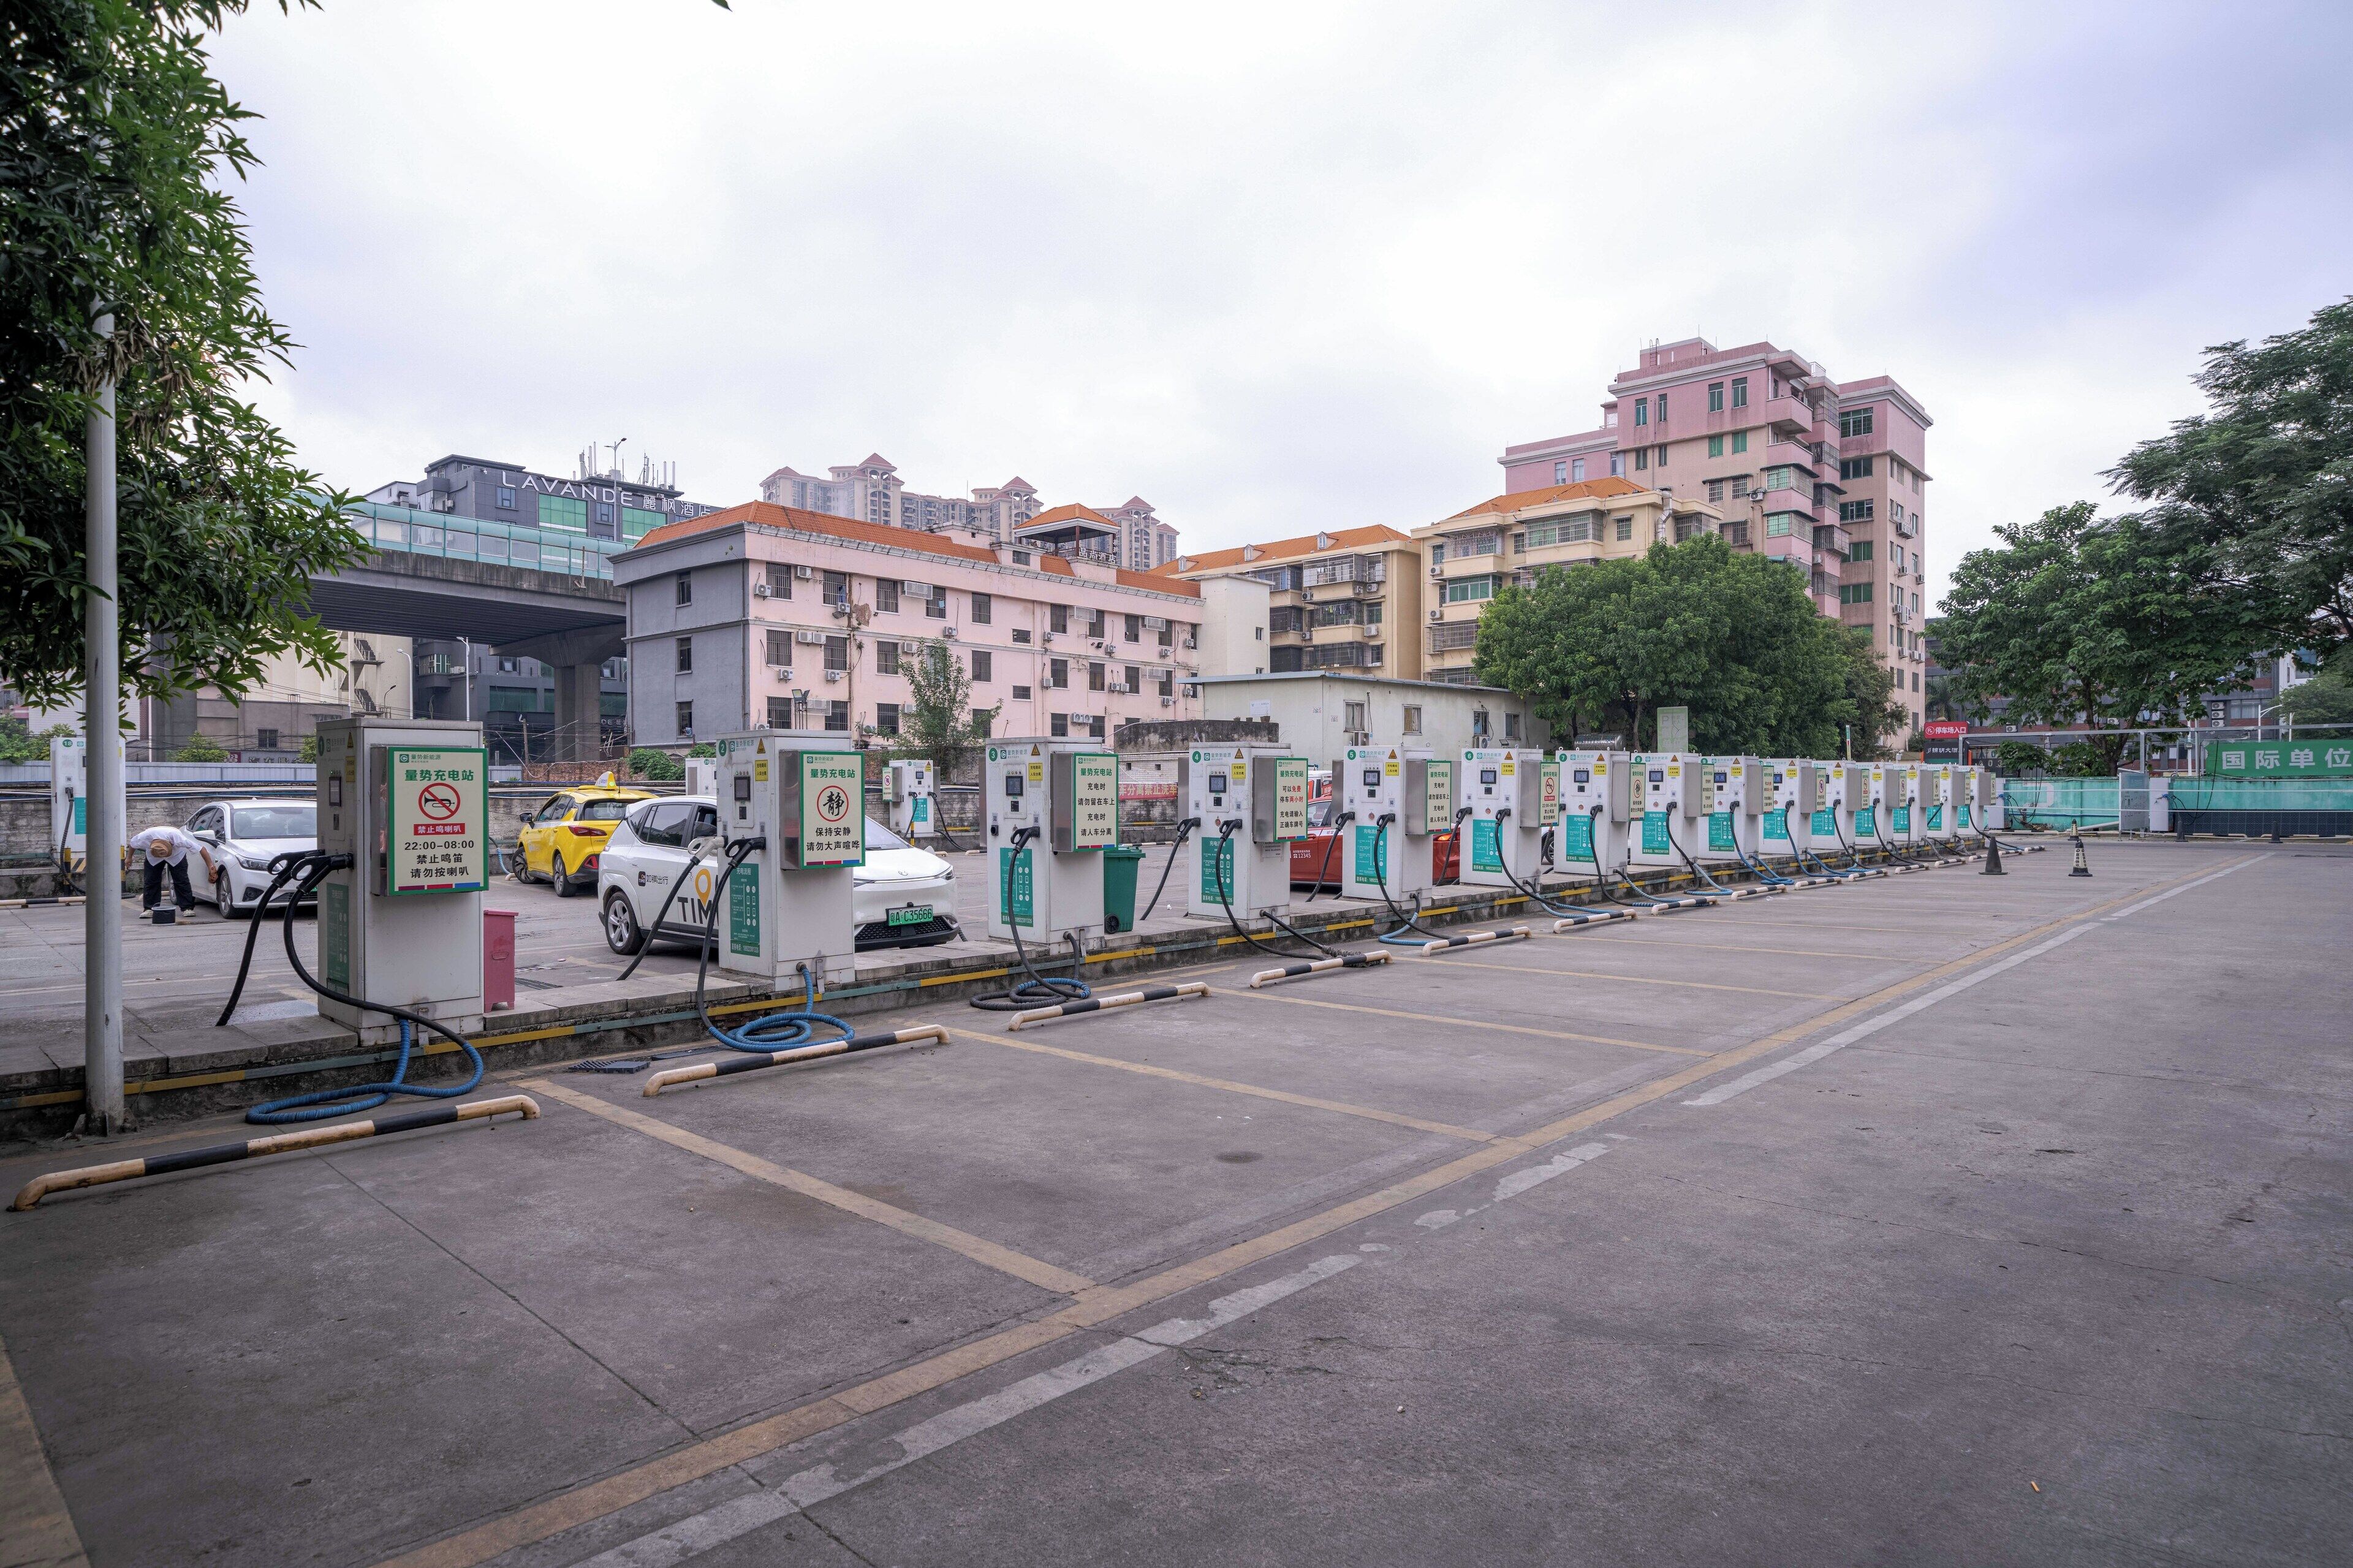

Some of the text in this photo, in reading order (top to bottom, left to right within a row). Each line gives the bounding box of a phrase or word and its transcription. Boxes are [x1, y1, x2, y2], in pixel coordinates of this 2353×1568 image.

[502, 471, 633, 507] LAVANDE
[1079, 547, 1116, 564] 品尚酒店
[721, 744, 724, 752] 2
[2222, 748, 2352, 769] 国际单位
[404, 769, 474, 781] 量势充电站
[810, 768, 855, 778] 量势充电站
[1080, 768, 1112, 776] 量势充电站
[822, 791, 845, 817] 静
[1078, 797, 1115, 806] 请勿留在车上
[815, 827, 851, 837] 保持安静
[1081, 828, 1112, 836] 请人车分离
[806, 840, 860, 851] 请勿大声喧哗
[417, 853, 463, 864] 禁止鸣笛
[411, 866, 469, 878] 请勿按喇叭
[646, 875, 669, 884] 如祺出行
[677, 896, 719, 926] TIM
